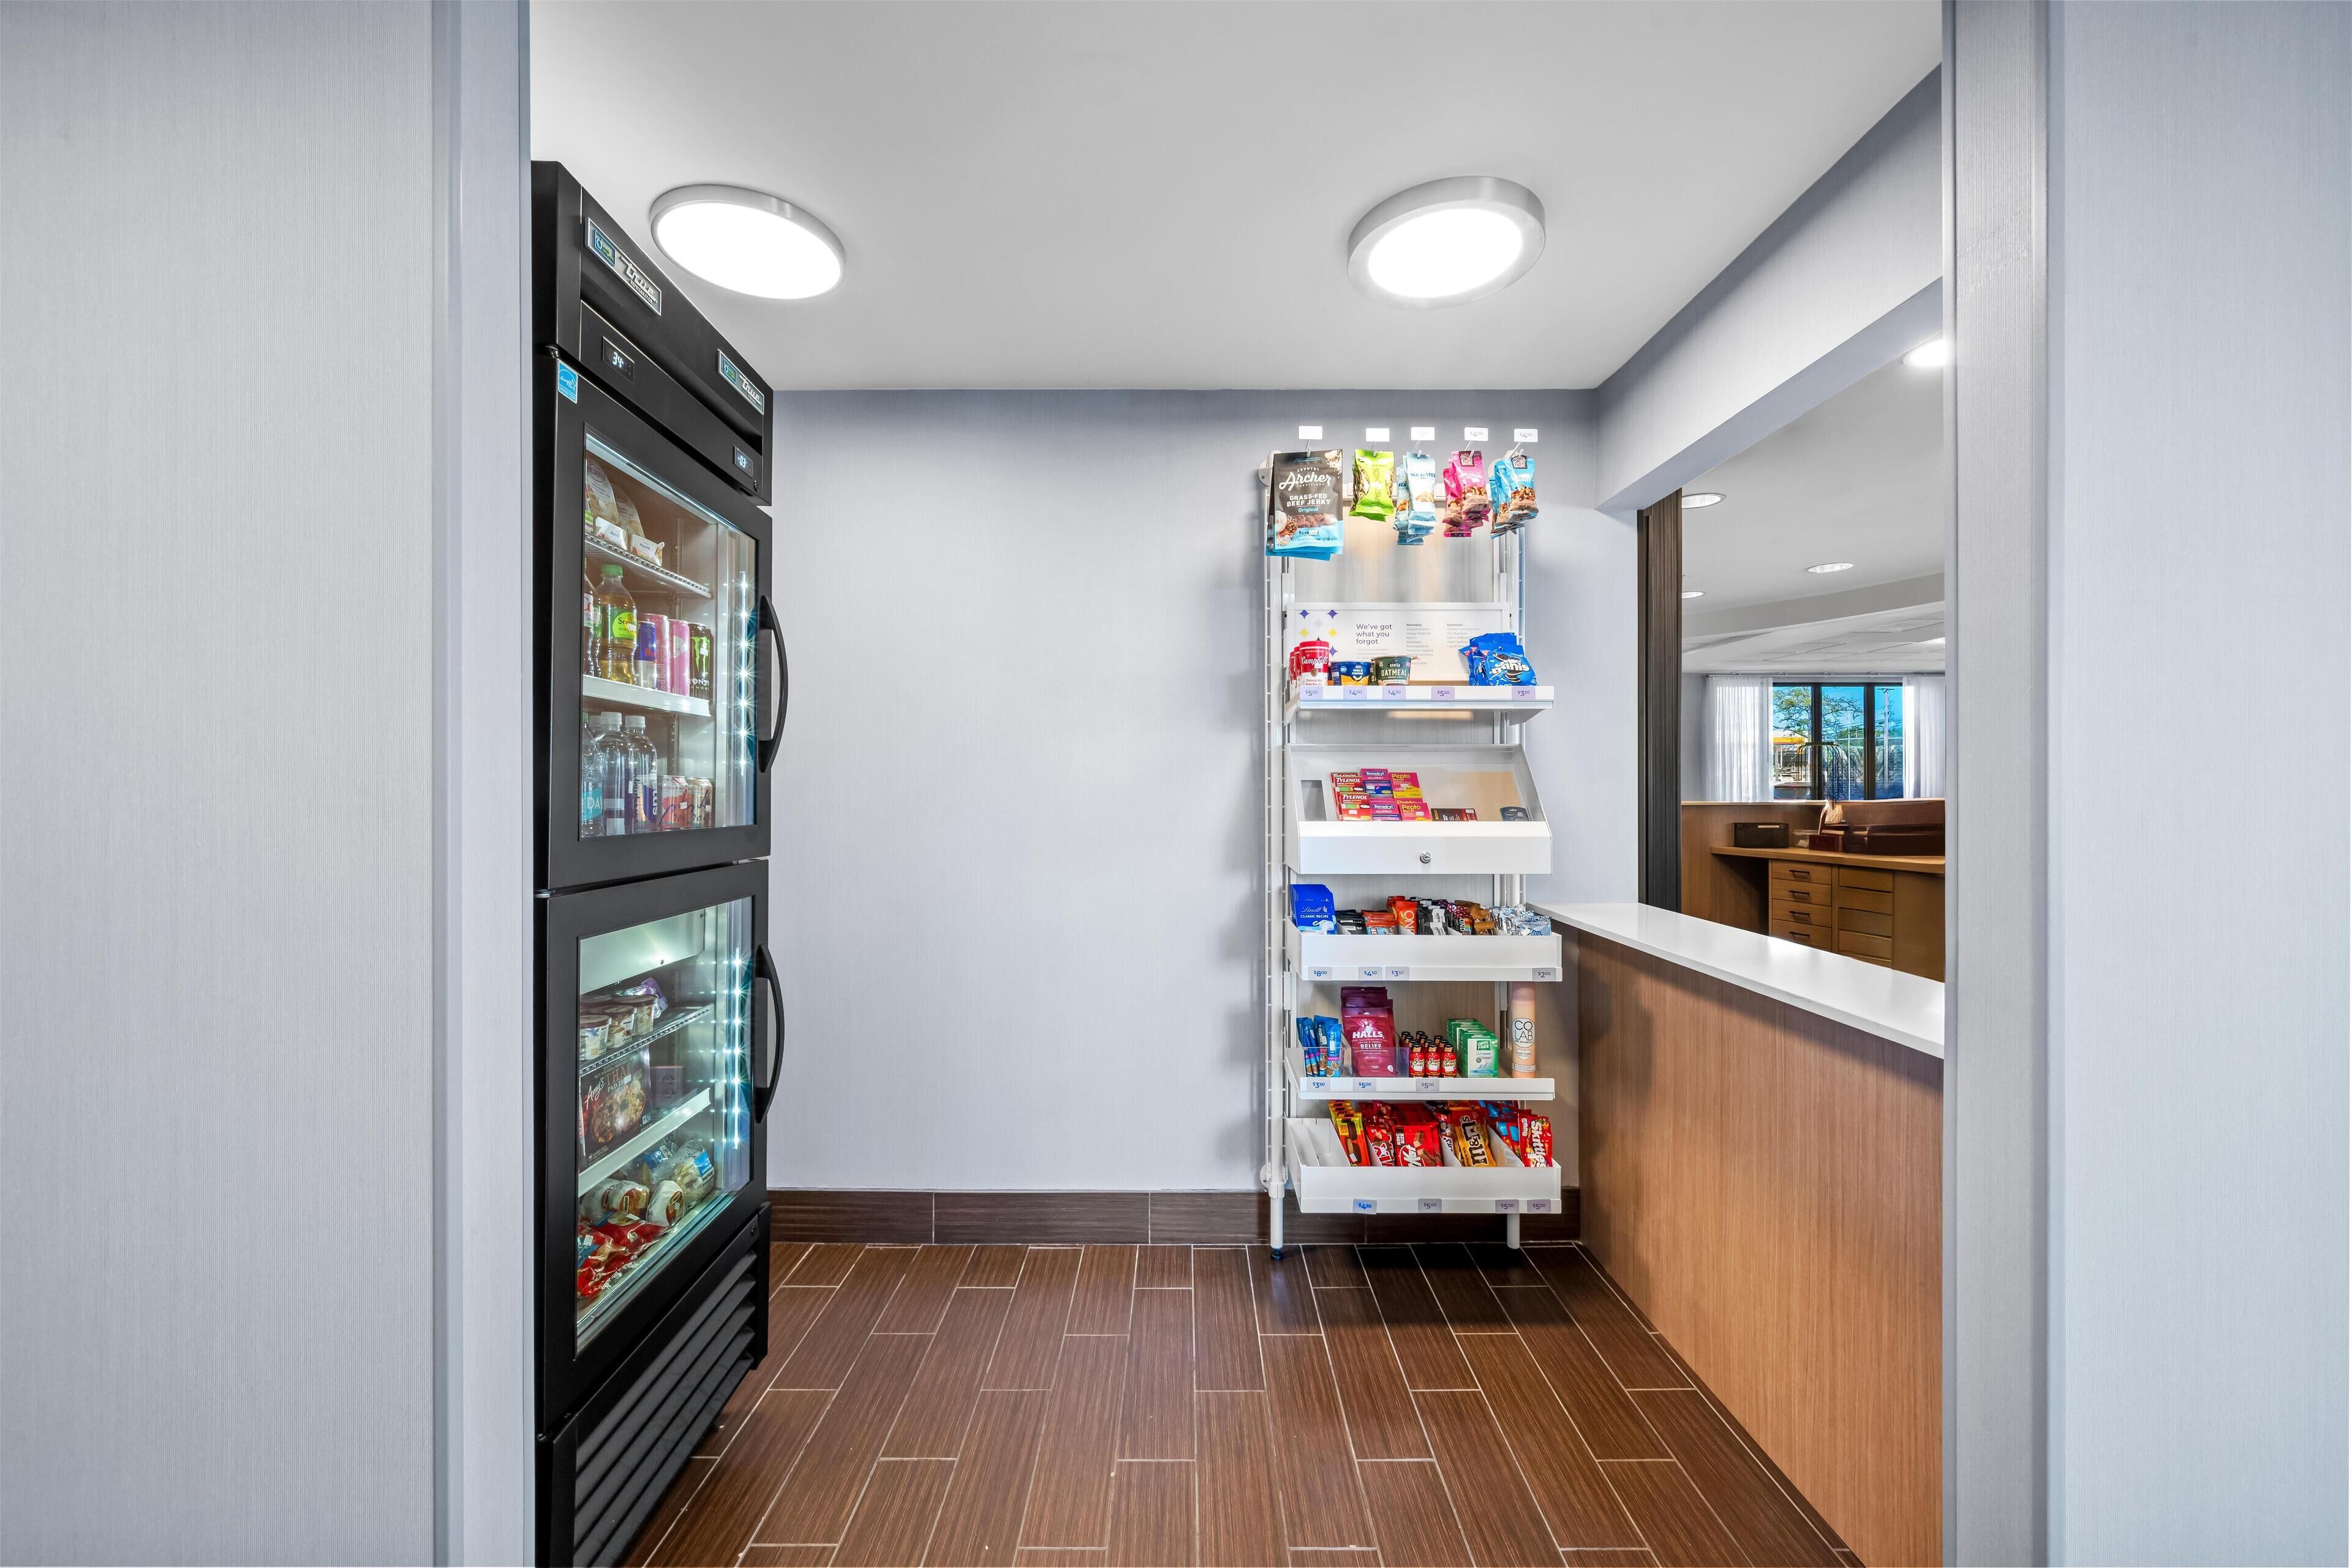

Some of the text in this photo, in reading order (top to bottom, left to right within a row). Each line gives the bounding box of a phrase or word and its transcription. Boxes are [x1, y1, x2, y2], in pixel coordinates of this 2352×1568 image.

[1278, 472, 1332, 491] Archer
[1514, 1020, 1533, 1031] CO
[1515, 1029, 1533, 1041] LAB
[605, 1063, 631, 1086] THAI
[584, 1076, 605, 1110] Amy's
[607, 1083, 617, 1092] PAD
[1531, 1120, 1547, 1167] Skittles
